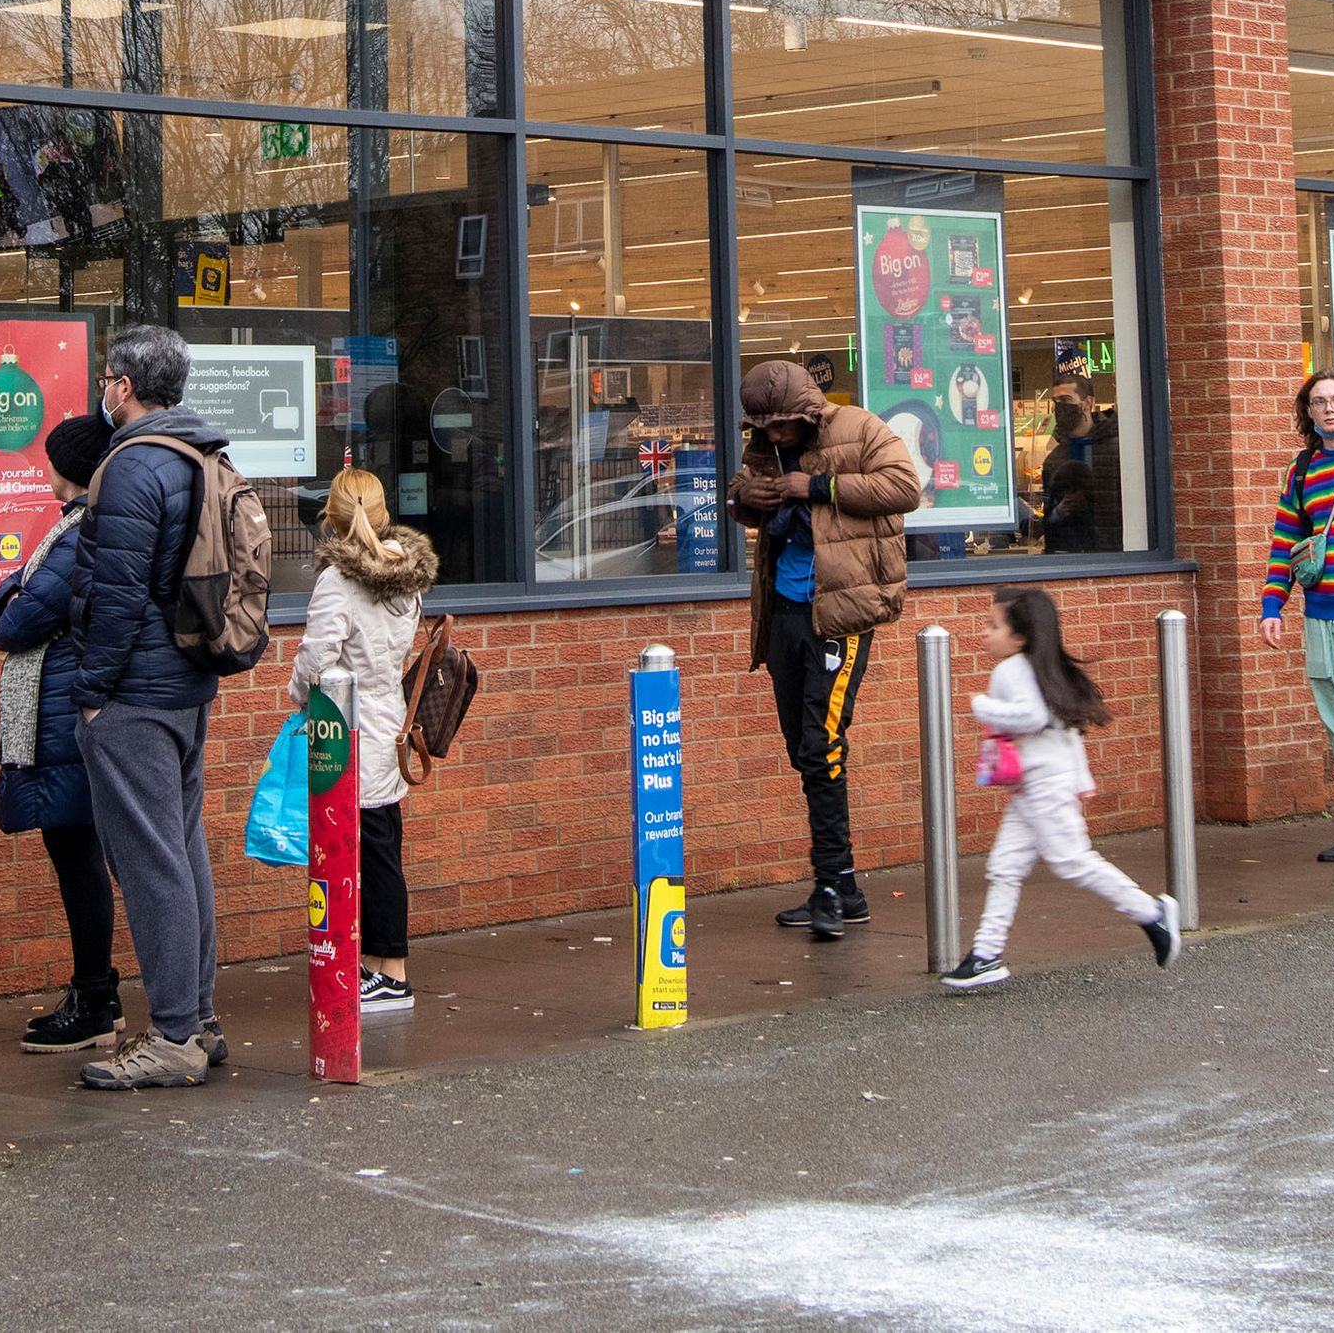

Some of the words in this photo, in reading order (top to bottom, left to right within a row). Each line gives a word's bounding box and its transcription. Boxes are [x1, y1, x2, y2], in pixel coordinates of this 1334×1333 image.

[880, 255, 902, 278] Big
[904, 254, 921, 270] on
[189, 366, 230, 378] Questions,
[232, 366, 270, 377] feedback
[1058, 356, 1087, 374] Middle
[815, 369, 833, 384] Lidl
[188, 383, 197, 391] or
[199, 381, 250, 393] suggestions?
[14, 392, 37, 406] on
[1, 466, 36, 480] yourself
[37, 469, 43, 477] a
[693, 477, 708, 491] Big
[693, 496, 705, 505] no
[694, 526, 714, 538] Plus
[694, 547, 705, 556] Our
[705, 547, 718, 555] bran
[694, 559, 716, 567] rewards
[642, 709, 664, 728] Big
[318, 719, 343, 740] on
[642, 734, 660, 746] no
[643, 751, 675, 768] that's
[643, 773, 673, 790] Plus
[645, 811, 664, 824] Our
[645, 825, 679, 840] rewards
